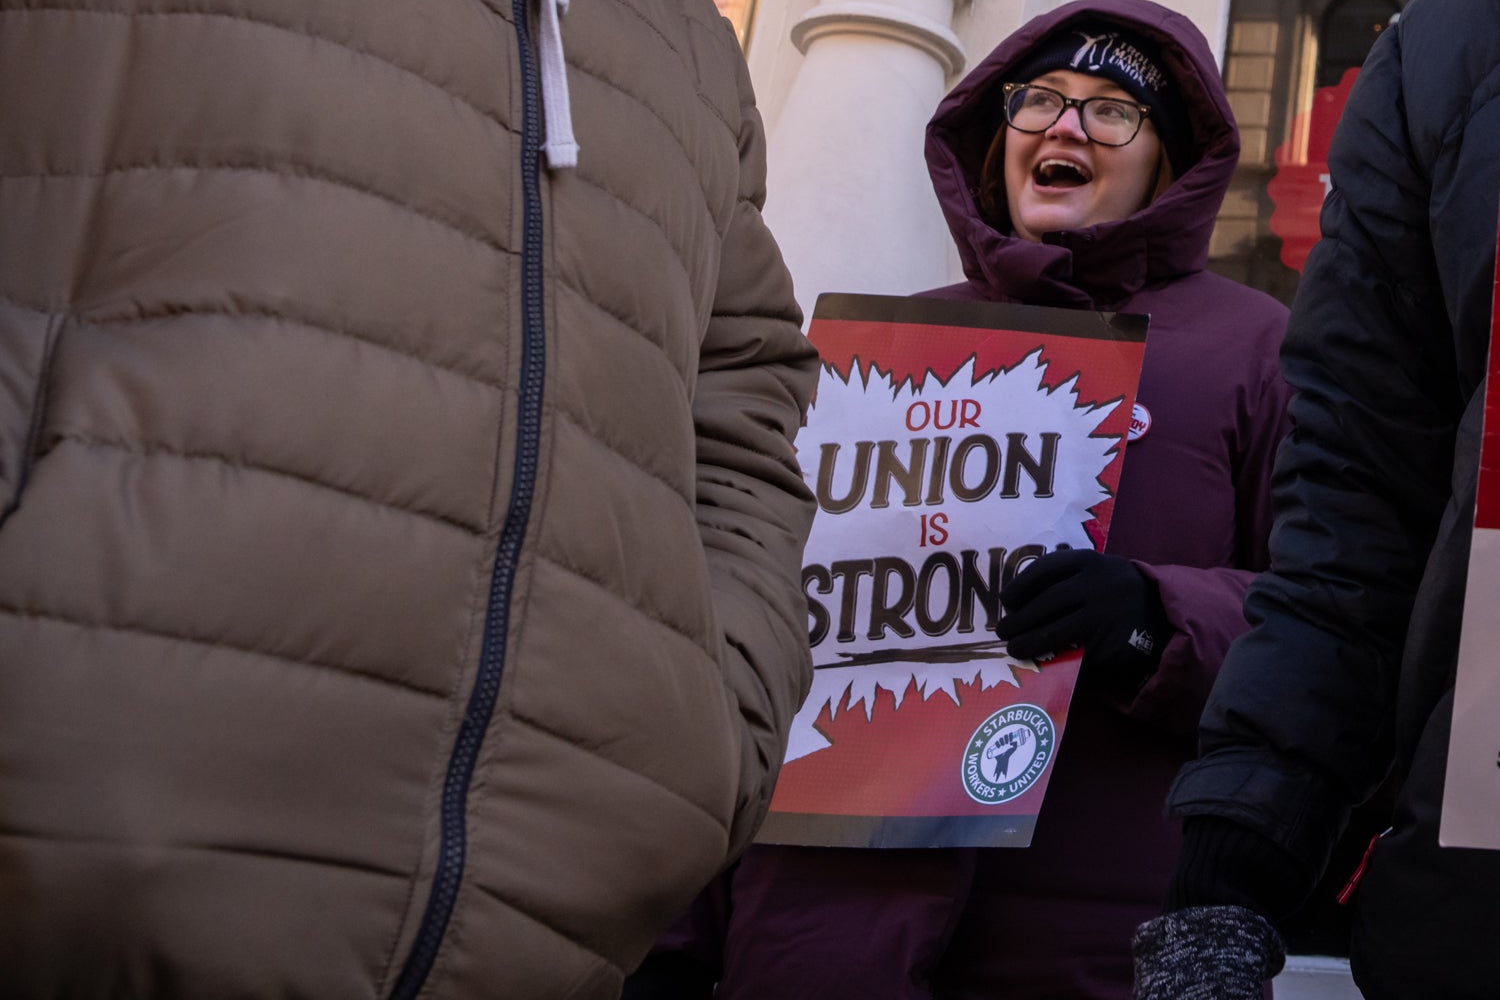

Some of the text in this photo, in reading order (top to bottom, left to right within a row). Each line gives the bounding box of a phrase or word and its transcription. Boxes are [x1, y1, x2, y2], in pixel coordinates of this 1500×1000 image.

[1108, 55, 1147, 88] UNION
[905, 399, 982, 432] OUR
[816, 432, 1062, 515] UNION
[920, 513, 949, 548] IS
[983, 709, 1049, 737] STARBUCKS
[967, 752, 996, 798] WORKERS
[1009, 750, 1047, 793] UNITED
